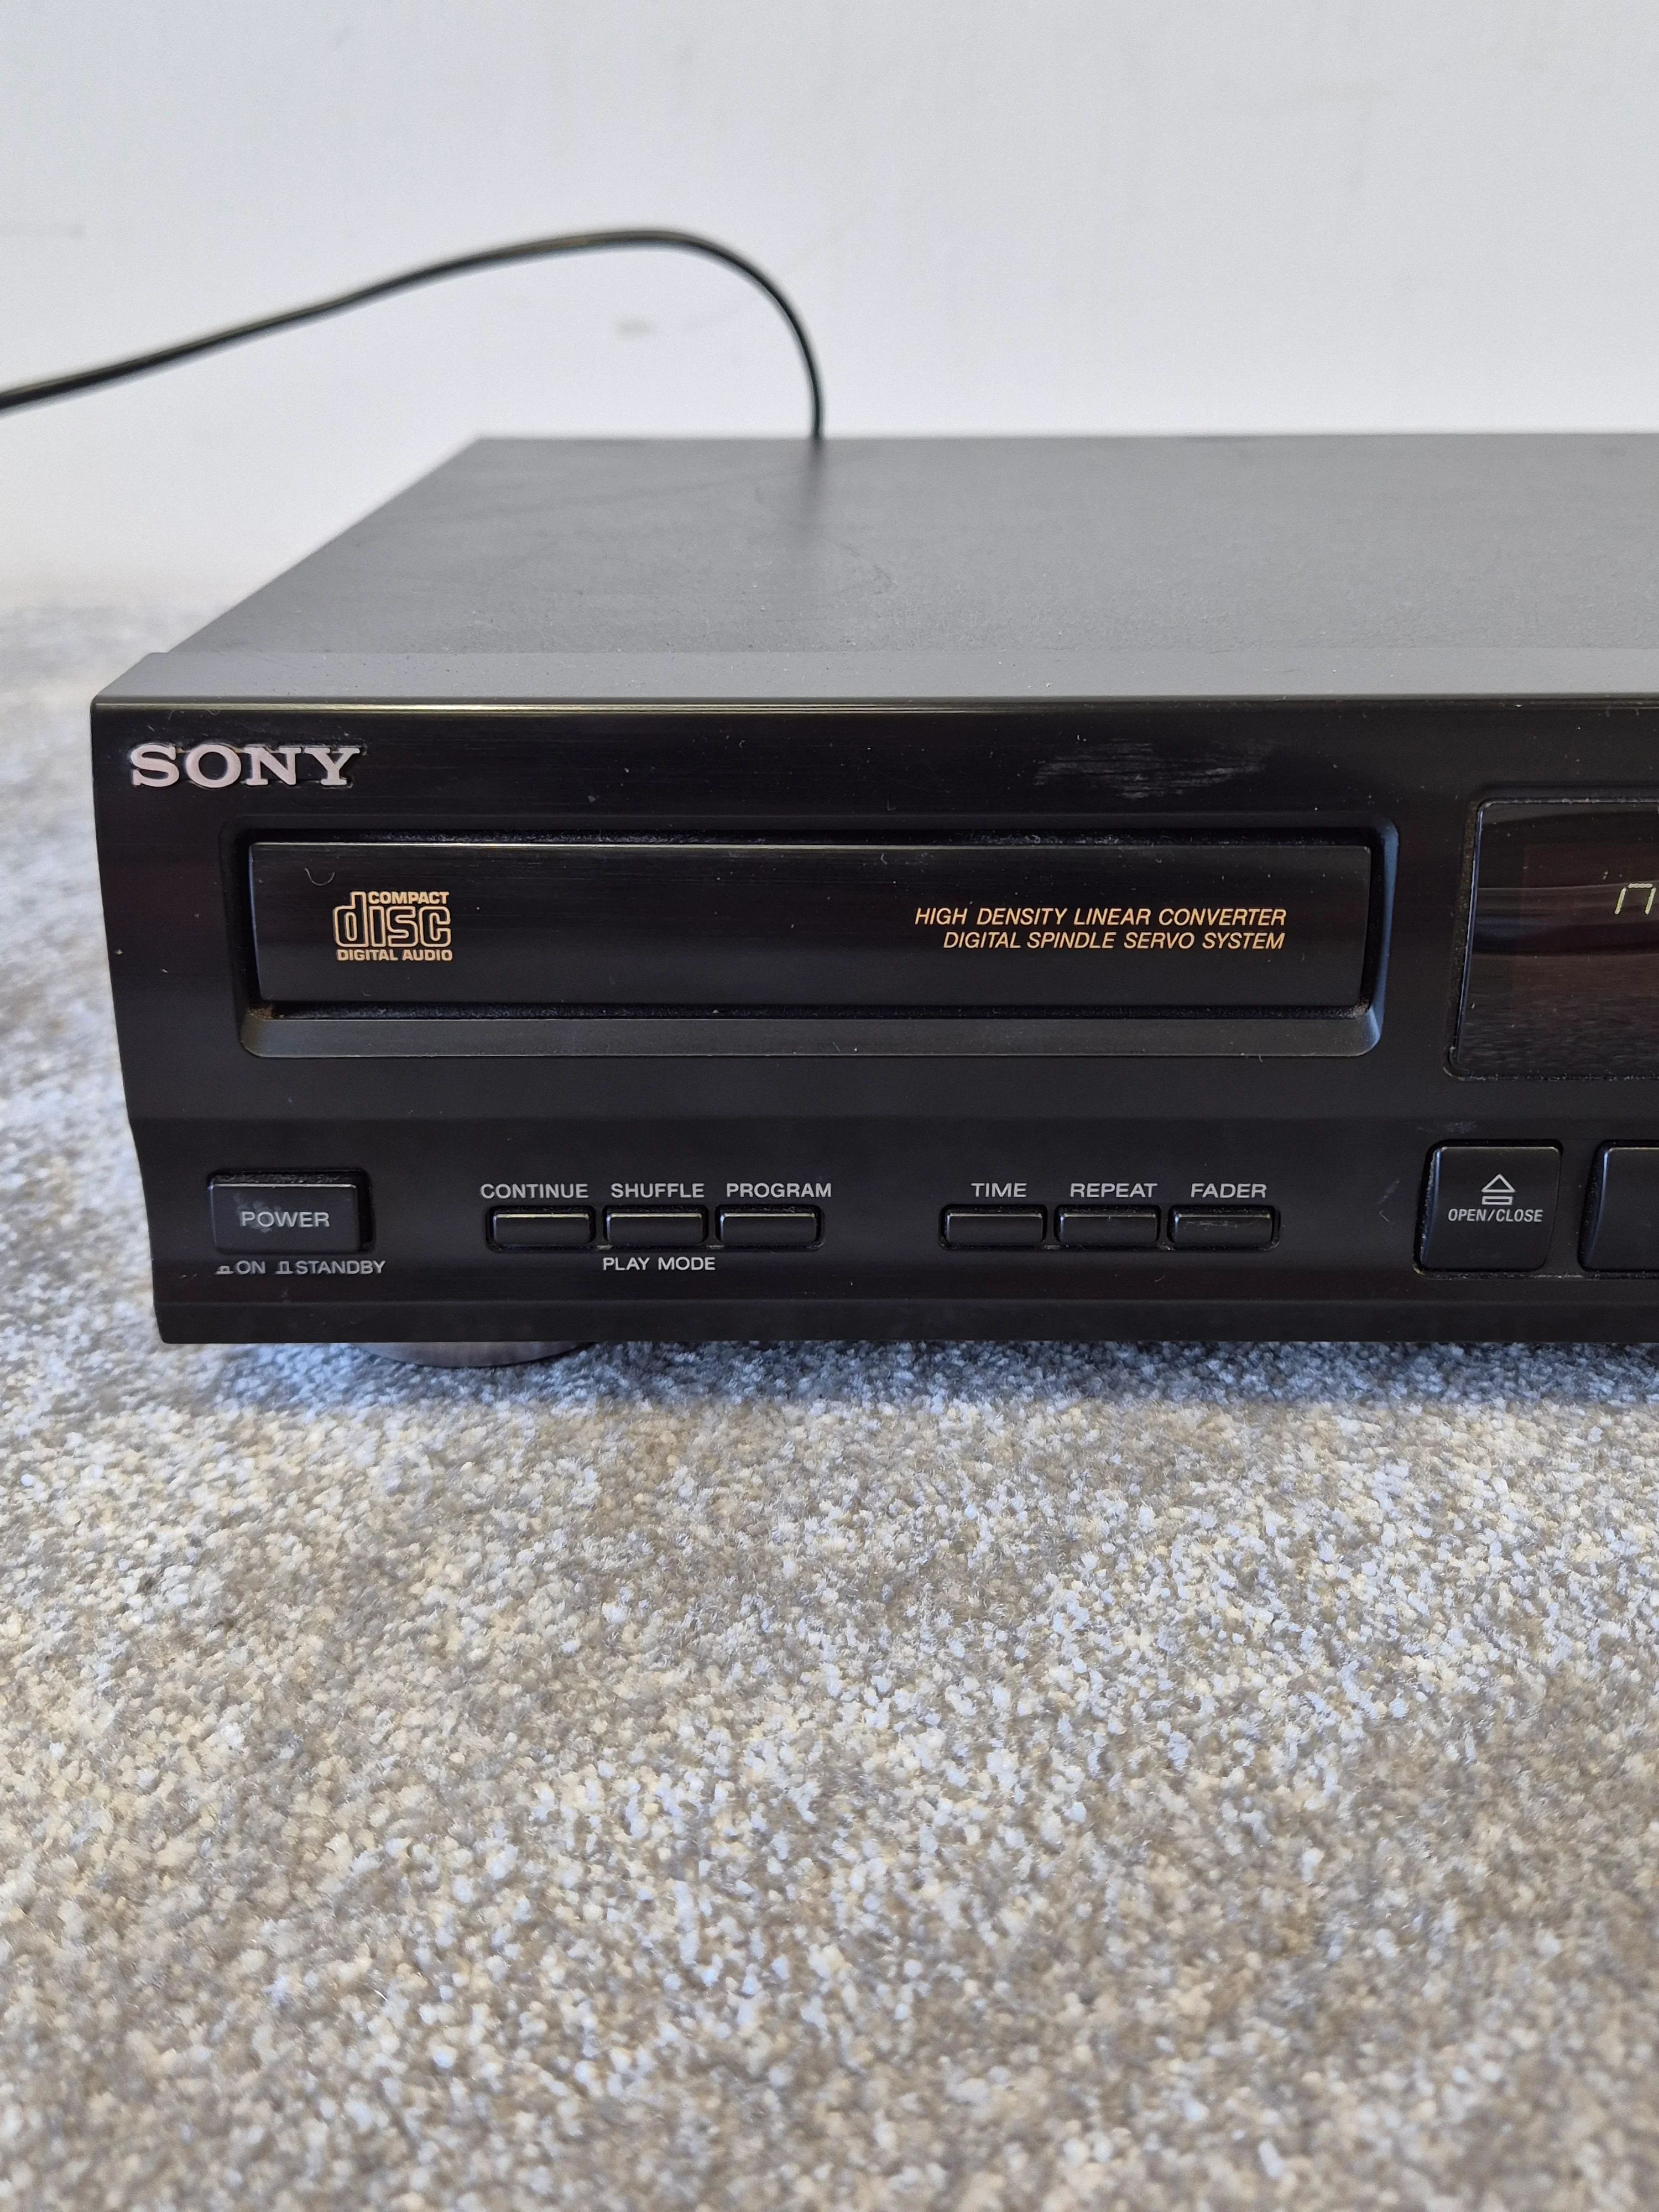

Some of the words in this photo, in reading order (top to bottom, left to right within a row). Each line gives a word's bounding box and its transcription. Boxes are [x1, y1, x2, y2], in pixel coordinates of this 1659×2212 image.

[129, 744, 361, 787] SONY
[368, 891, 449, 905] COMPACT
[915, 907, 968, 925] HIGH
[976, 907, 1067, 926] DENSITY
[1073, 908, 1150, 926] LINEAR
[1159, 908, 1287, 927] CONVERTER
[943, 932, 1021, 949] DIGITAL
[1027, 932, 1115, 949] SPINDLE
[1123, 932, 1195, 949] SERVO
[1202, 933, 1286, 950] SYSTEM
[337, 949, 399, 961] DIGITAL
[402, 949, 453, 961] AUDIO
[480, 1183, 589, 1199] CONTINUE
[611, 1183, 705, 1199] SHUFFLE
[726, 1183, 832, 1199] PROGRAM
[971, 1183, 1027, 1198] TIME
[1070, 1183, 1158, 1198] REPEAT
[1191, 1183, 1267, 1199] FADER
[240, 1211, 330, 1228] POWER
[1448, 1208, 1543, 1223] OPEN/CLOSE
[236, 1260, 266, 1274] ON
[295, 1260, 386, 1274] STANDBY
[602, 1257, 651, 1271] PLAY
[658, 1257, 716, 1271] MODE
